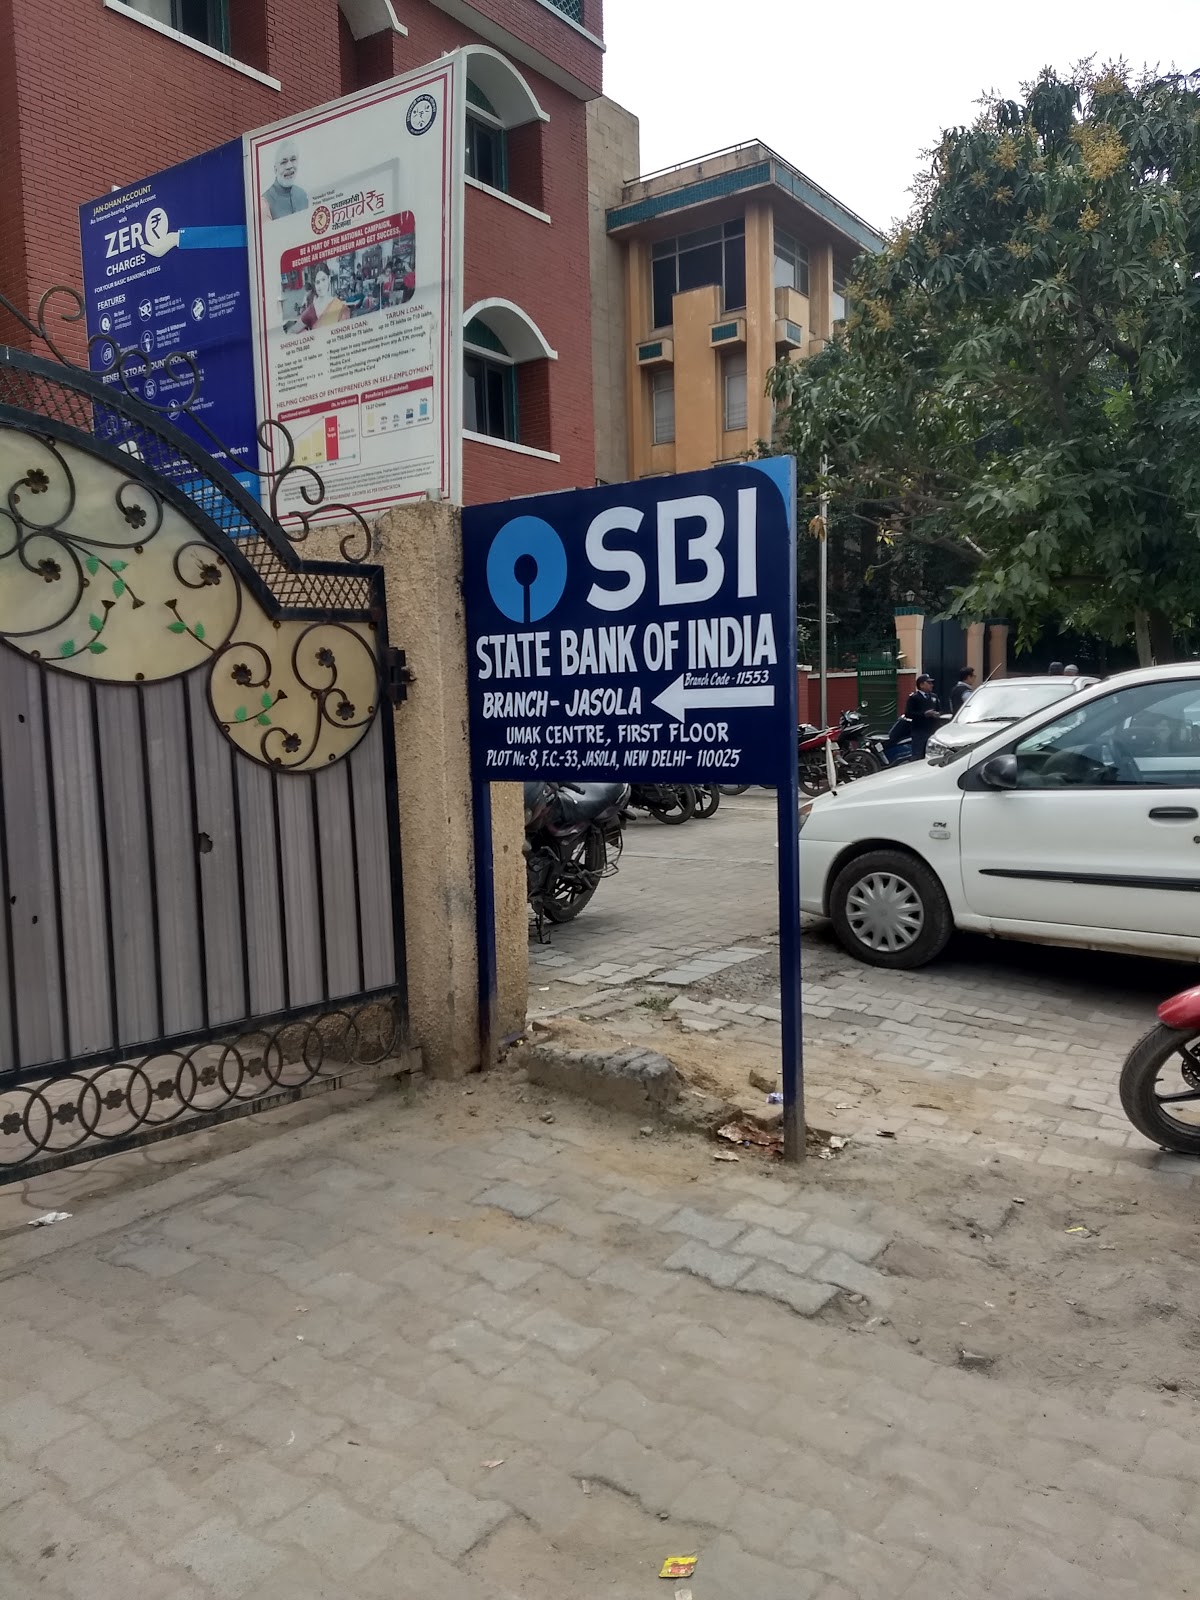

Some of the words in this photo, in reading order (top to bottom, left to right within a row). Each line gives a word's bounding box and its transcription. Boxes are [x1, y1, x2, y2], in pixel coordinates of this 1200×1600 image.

[93, 198, 121, 216] JAN-DHAN
[122, 184, 151, 203] ACCOUNT
[125, 199, 139, 212] Savings
[139, 192, 156, 205] Account
[292, 255, 311, 267] BECOME
[311, 252, 318, 261] AN
[318, 241, 354, 258] ENTREPRENEUR
[355, 237, 365, 247] AND
[366, 233, 376, 243] GET
[300, 247, 305, 255] BE
[311, 241, 322, 252] PART
[323, 239, 329, 247] OF
[330, 236, 340, 245] THE
[340, 228, 362, 242] NATIONAL
[106, 253, 146, 277] CHARGES
[94, 285, 102, 293] FOR
[103, 281, 113, 290] YOUR
[114, 277, 126, 286] BASIC
[126, 270, 146, 282] BANKING
[146, 265, 160, 275] NEEDS
[97, 293, 125, 310] FEATURES
[386, 309, 404, 319] TARUN
[330, 324, 350, 335] KISHOR
[279, 339, 298, 349] SHISHU
[276, 398, 297, 408] HELPING
[298, 392, 318, 402] CRORES
[327, 379, 371, 396] ENTREPRENEURS
[379, 364, 432, 383] SELF-EMPLOYMENT
[585, 487, 757, 611] SBI
[476, 631, 551, 680] STATE
[560, 625, 638, 676] BANK
[643, 620, 679, 672] OF
[687, 613, 778, 669] INDIA
[684, 672, 708, 686] Branch
[710, 672, 730, 686] Code
[565, 686, 642, 716] JASOLA
[506, 726, 542, 744] UMAK
[546, 724, 612, 746] CENTRE,
[618, 723, 663, 744] FIRST
[669, 722, 729, 743] FLOOR
[486, 750, 512, 766] PLOT
[624, 750, 649, 766] NEW
[652, 750, 692, 767] DELHI-
[697, 748, 742, 768] 110025
